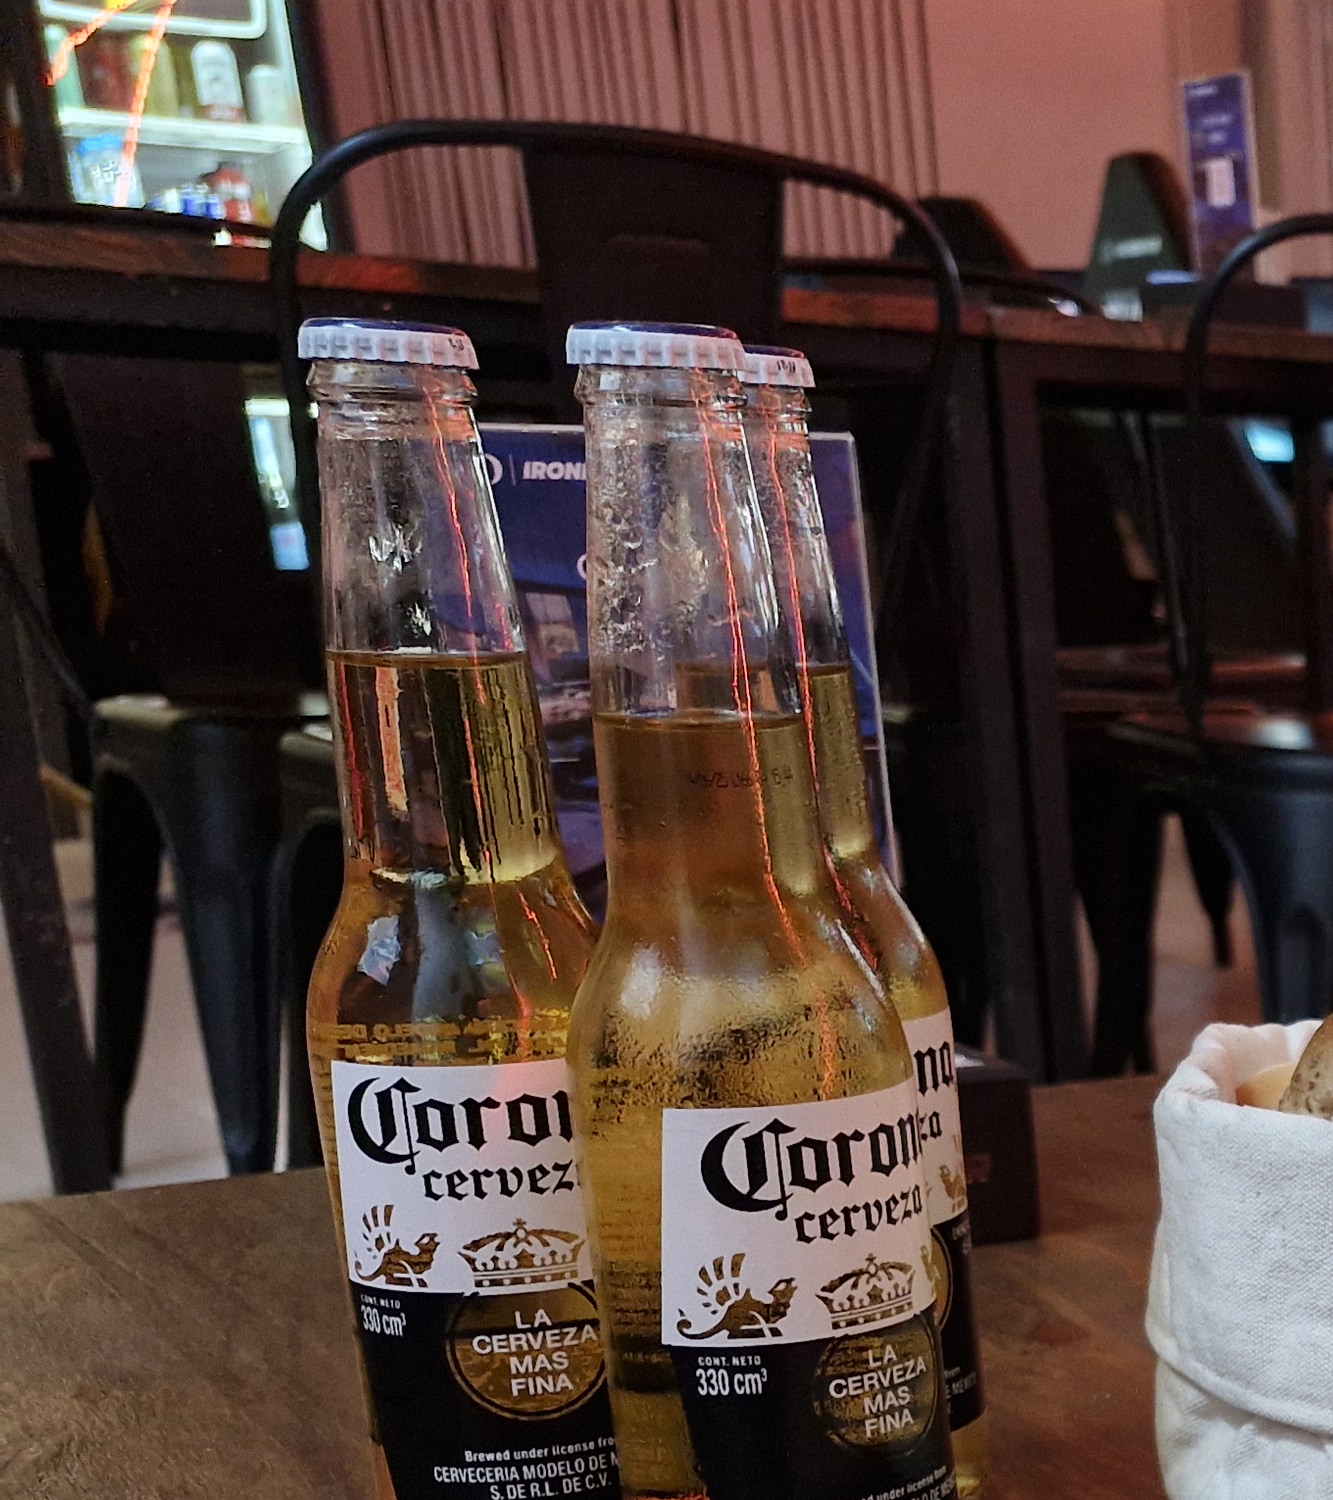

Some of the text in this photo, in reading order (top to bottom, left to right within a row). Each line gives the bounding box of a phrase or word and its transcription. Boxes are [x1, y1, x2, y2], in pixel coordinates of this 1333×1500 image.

[700, 1107, 923, 1221] Coron
[422, 1159, 580, 1201] cervez
[794, 1184, 922, 1243] cerveza
[361, 1304, 381, 1334] 330
[514, 1308, 553, 1330] LA
[472, 1324, 598, 1355] CERVEZA
[510, 1351, 570, 1375] MAS
[732, 1355, 762, 1366] NETO
[868, 1344, 897, 1368] LA
[510, 1374, 574, 1397] FINA
[696, 1368, 730, 1396] 330
[828, 1355, 928, 1399] CERVEZA
[863, 1385, 911, 1416] MAS
[864, 1408, 914, 1438] FINA
[464, 1437, 617, 1463] Brewed under license fro
[433, 1465, 520, 1484] CERVECERIA
[522, 1458, 585, 1481] MODELO
[588, 1454, 608, 1471] DE
[490, 1472, 613, 1500] S. DE R.L. DE C.V.
